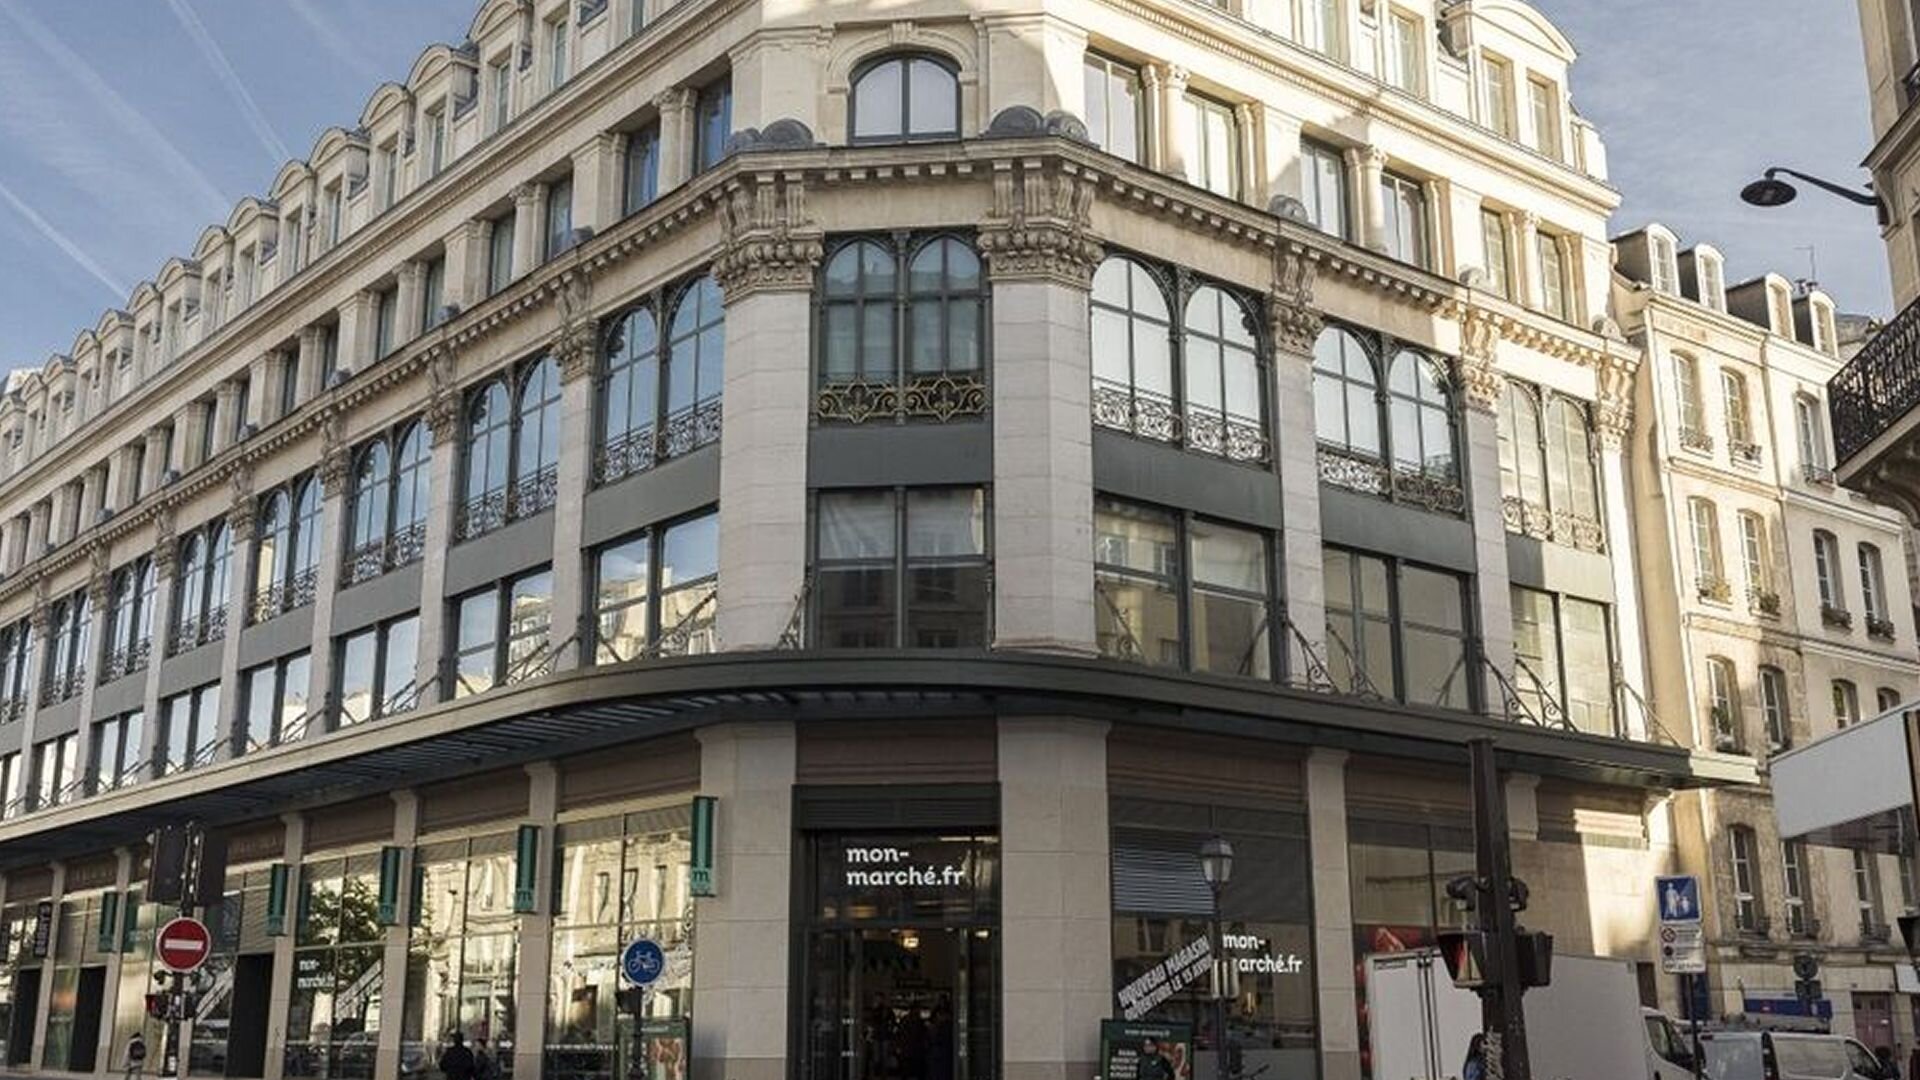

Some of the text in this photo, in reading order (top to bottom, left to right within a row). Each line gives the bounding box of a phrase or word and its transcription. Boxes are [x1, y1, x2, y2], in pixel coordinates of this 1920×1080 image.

[846, 848, 909, 862] mon-
[846, 865, 964, 885] marché.fr
[1222, 933, 1265, 949] mon-
[1118, 934, 1209, 1008] NOUVEAU MAGASIN
[1232, 953, 1303, 973] arché.fr
